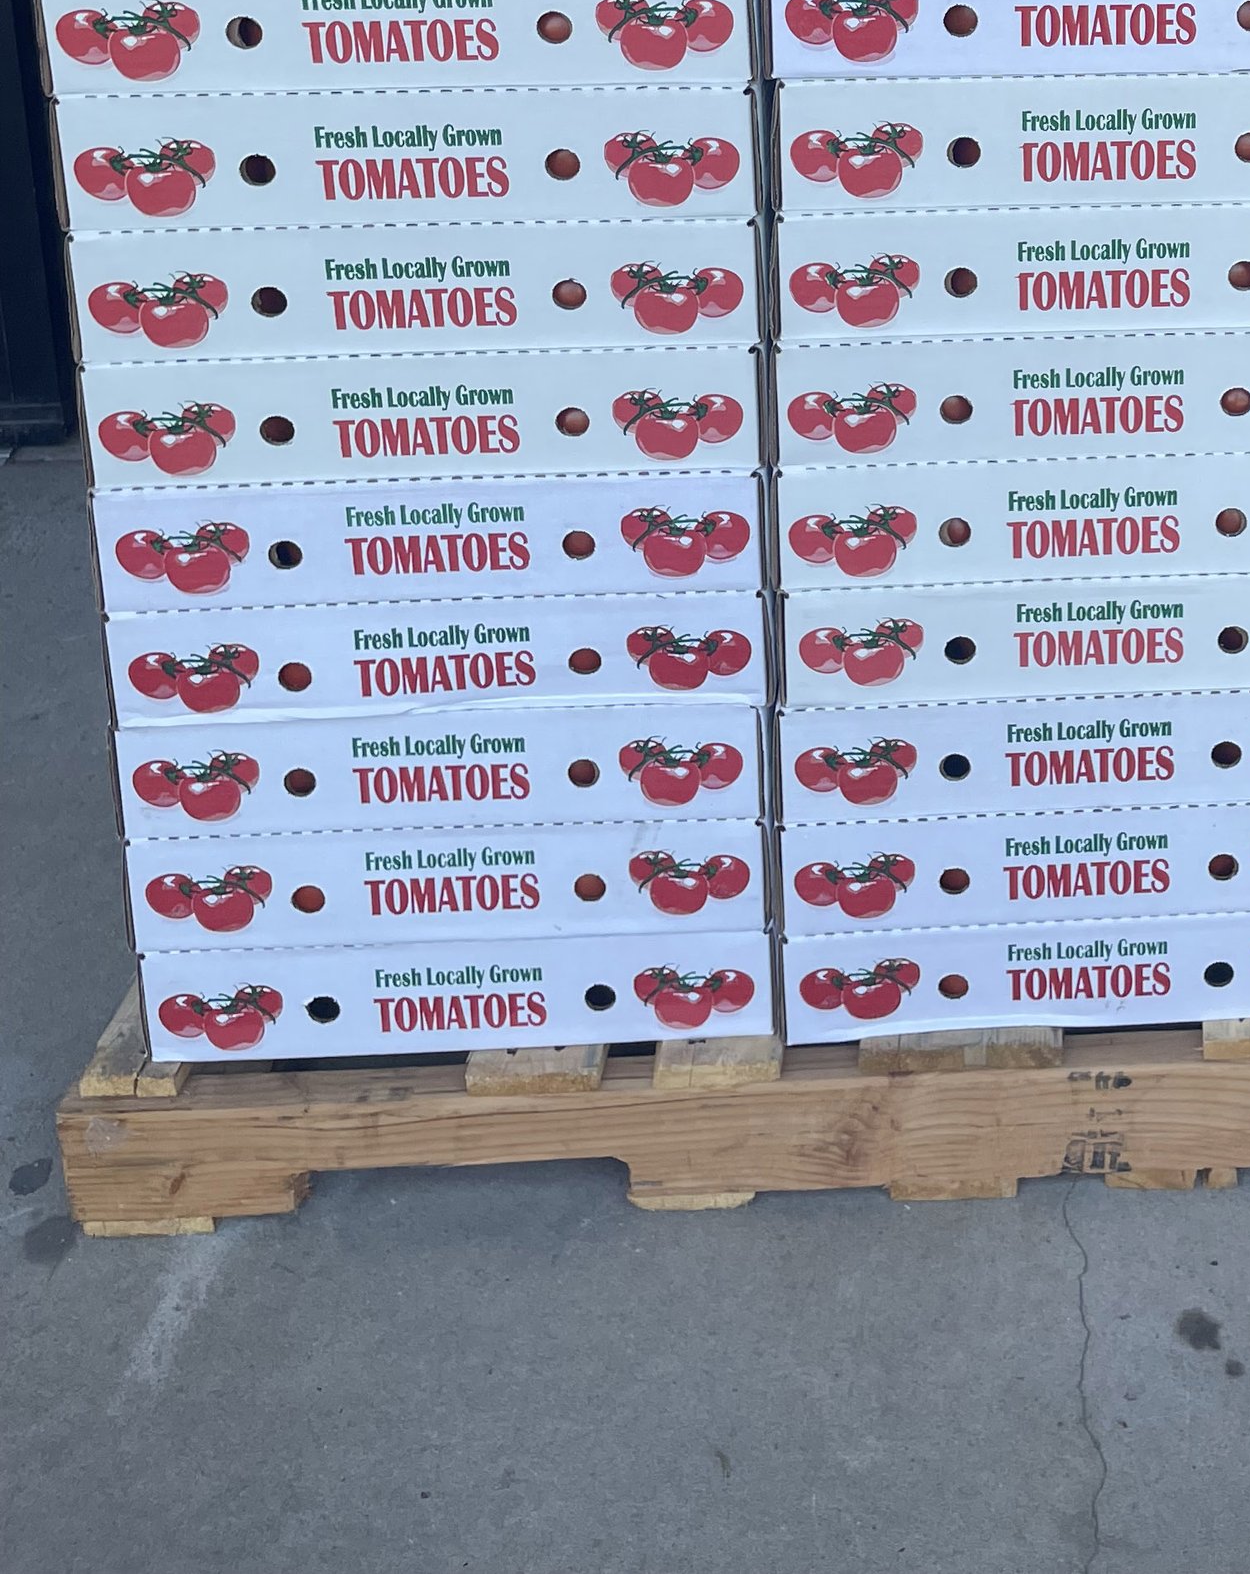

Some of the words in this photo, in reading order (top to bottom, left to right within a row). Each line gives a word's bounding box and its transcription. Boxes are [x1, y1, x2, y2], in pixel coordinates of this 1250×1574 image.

[1015, 2, 1195, 46] TOMATOES
[314, 126, 367, 148] Fresh
[372, 125, 437, 151] Locally
[442, 124, 502, 146] Grown
[316, 156, 508, 199] TOMATOES
[1009, 490, 1055, 511] Fresh
[1061, 488, 1120, 512] Locally
[1124, 487, 1177, 507] Grown
[1008, 515, 1179, 558] TOMATOES
[354, 628, 403, 650] Fresh
[408, 625, 469, 649] Locally
[474, 624, 530, 644] Grown
[356, 651, 534, 695] TOMATOES
[1008, 941, 1051, 961] Fresh
[1057, 940, 1112, 961] Locally
[1118, 939, 1167, 956] Grown
[1009, 964, 1169, 998] TOMATOES
